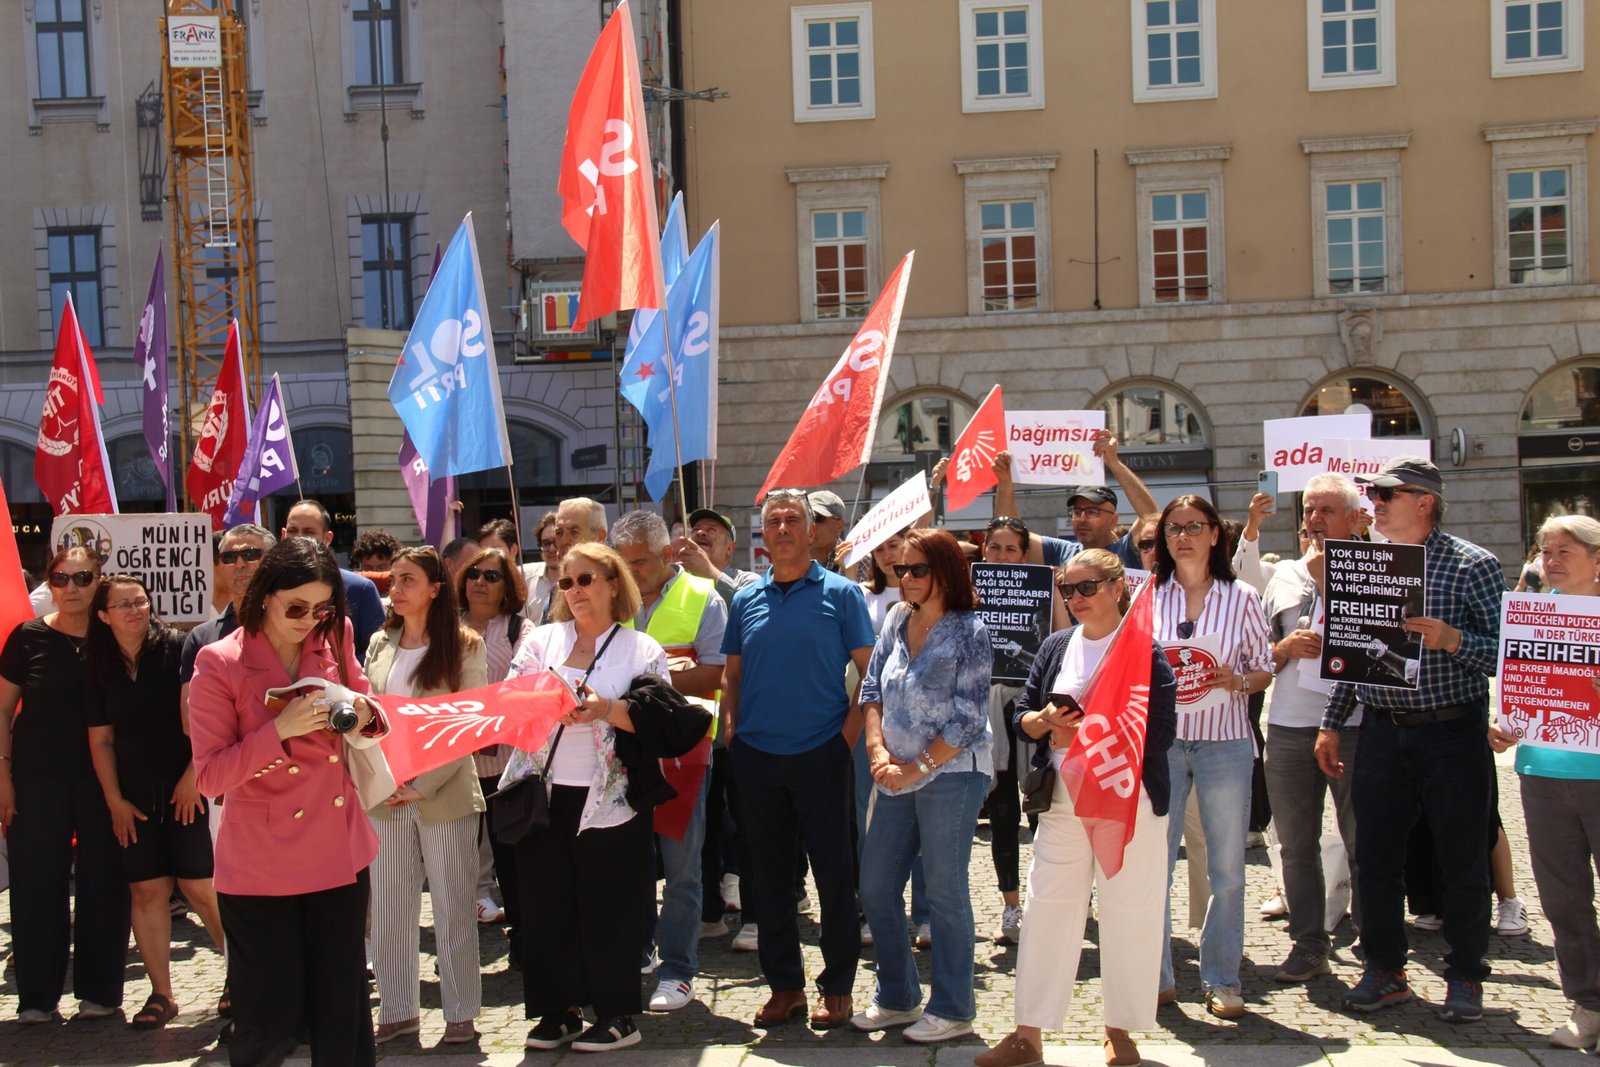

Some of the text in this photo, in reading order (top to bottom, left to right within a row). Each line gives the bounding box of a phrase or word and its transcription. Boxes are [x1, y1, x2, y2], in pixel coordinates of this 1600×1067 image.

[174, 26, 216, 42] FRANK
[1010, 424, 1101, 446] bağımsız
[1030, 453, 1080, 472] yargı
[1327, 457, 1384, 474] Meinu
[12, 525, 41, 533] UCA
[142, 521, 206, 544] MÜNİH
[117, 545, 202, 569] ÖĞRENCİ
[1330, 549, 1393, 562] YOK BU İŞİN
[1330, 559, 1386, 573] SAĞI SOLU
[976, 569, 1028, 580] YOK BU İŞİN
[1330, 572, 1421, 587] YA HEP BERABER
[975, 578, 1022, 588] SAĞI SOLU
[1330, 583, 1343, 592] YA
[1346, 583, 1402, 597] HİÇBİRİMİZ
[987, 589, 1006, 597] HEP
[1007, 590, 1050, 599] BERABER
[987, 597, 1035, 608] HİÇBİRİMİZ
[1330, 600, 1399, 619] FREIHEIT
[1508, 600, 1556, 613] NEIN ZUM
[1341, 617, 1363, 626] EKREM
[1507, 612, 1565, 626] POLITISCHEN
[1330, 624, 1361, 634] UND ALLE
[1533, 628, 1600, 643] IN DER TÜRKE
[1329, 631, 1372, 643] WILLKÜRLICH
[1506, 641, 1600, 665] FREIHEIT
[1519, 663, 1551, 674] EKREM
[1552, 664, 1598, 678] İMAMOĞL
[1504, 673, 1547, 685] UND ALLE
[1503, 684, 1563, 697] WILLKÜRLICH
[397, 700, 485, 715] CHP
[1503, 695, 1590, 711] FESTGENOMMENEN
[1077, 713, 1135, 799] CHP
